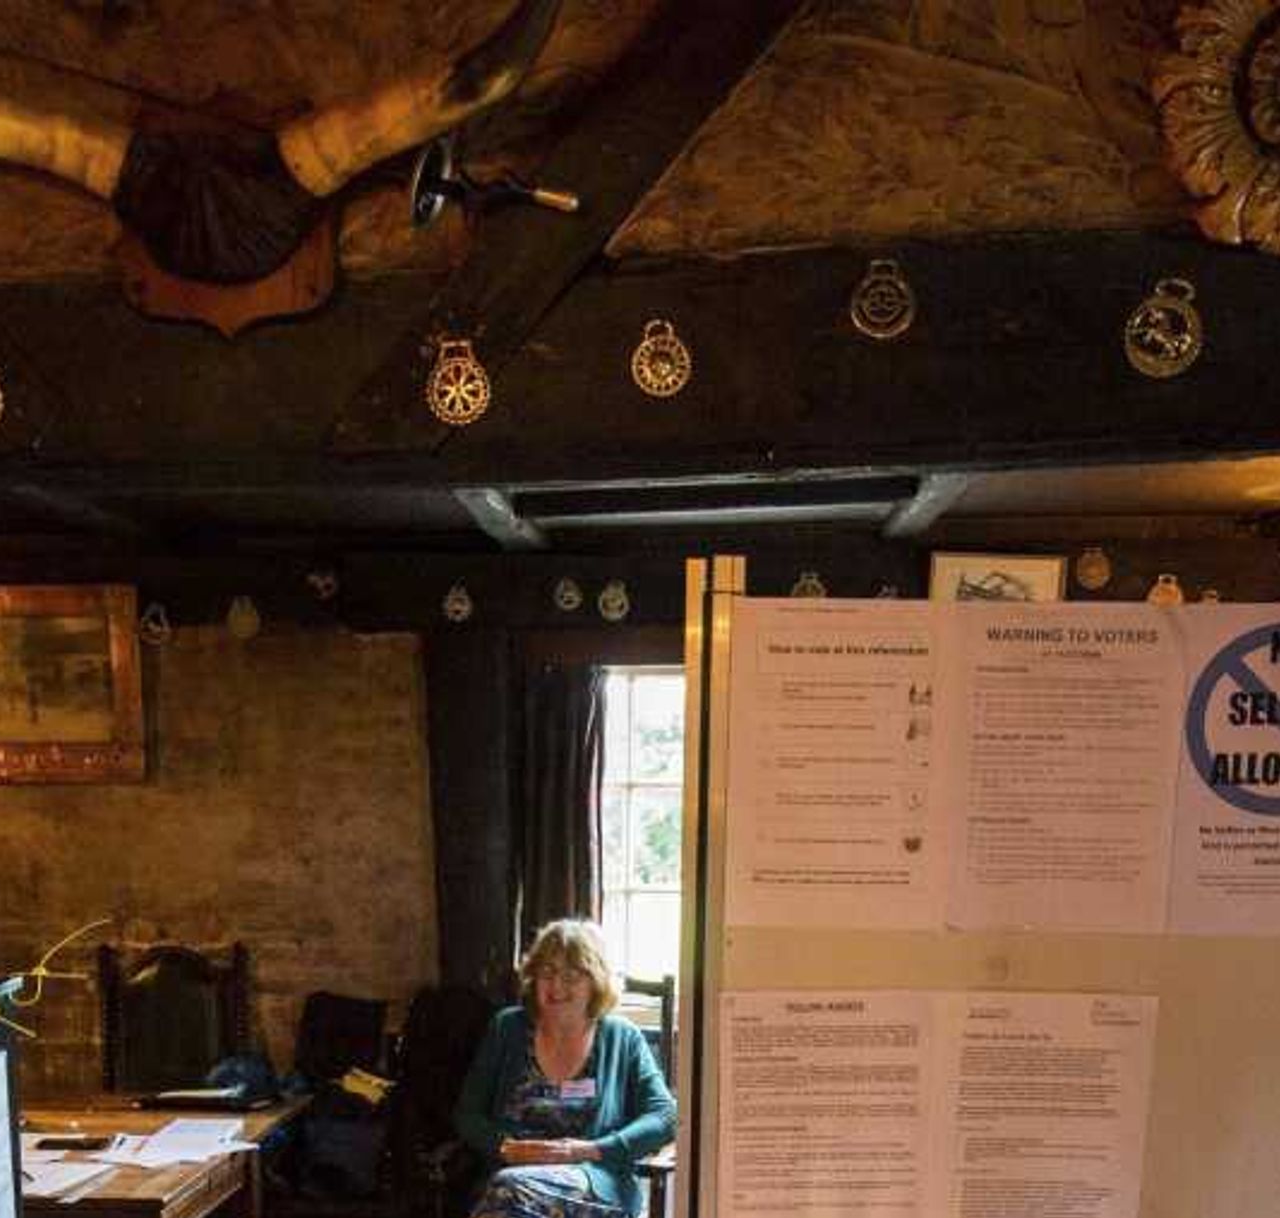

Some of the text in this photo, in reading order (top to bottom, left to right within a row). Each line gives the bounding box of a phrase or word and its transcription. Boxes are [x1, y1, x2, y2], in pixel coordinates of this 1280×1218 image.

[986, 627, 1160, 645] WARNING TO VOTERS
